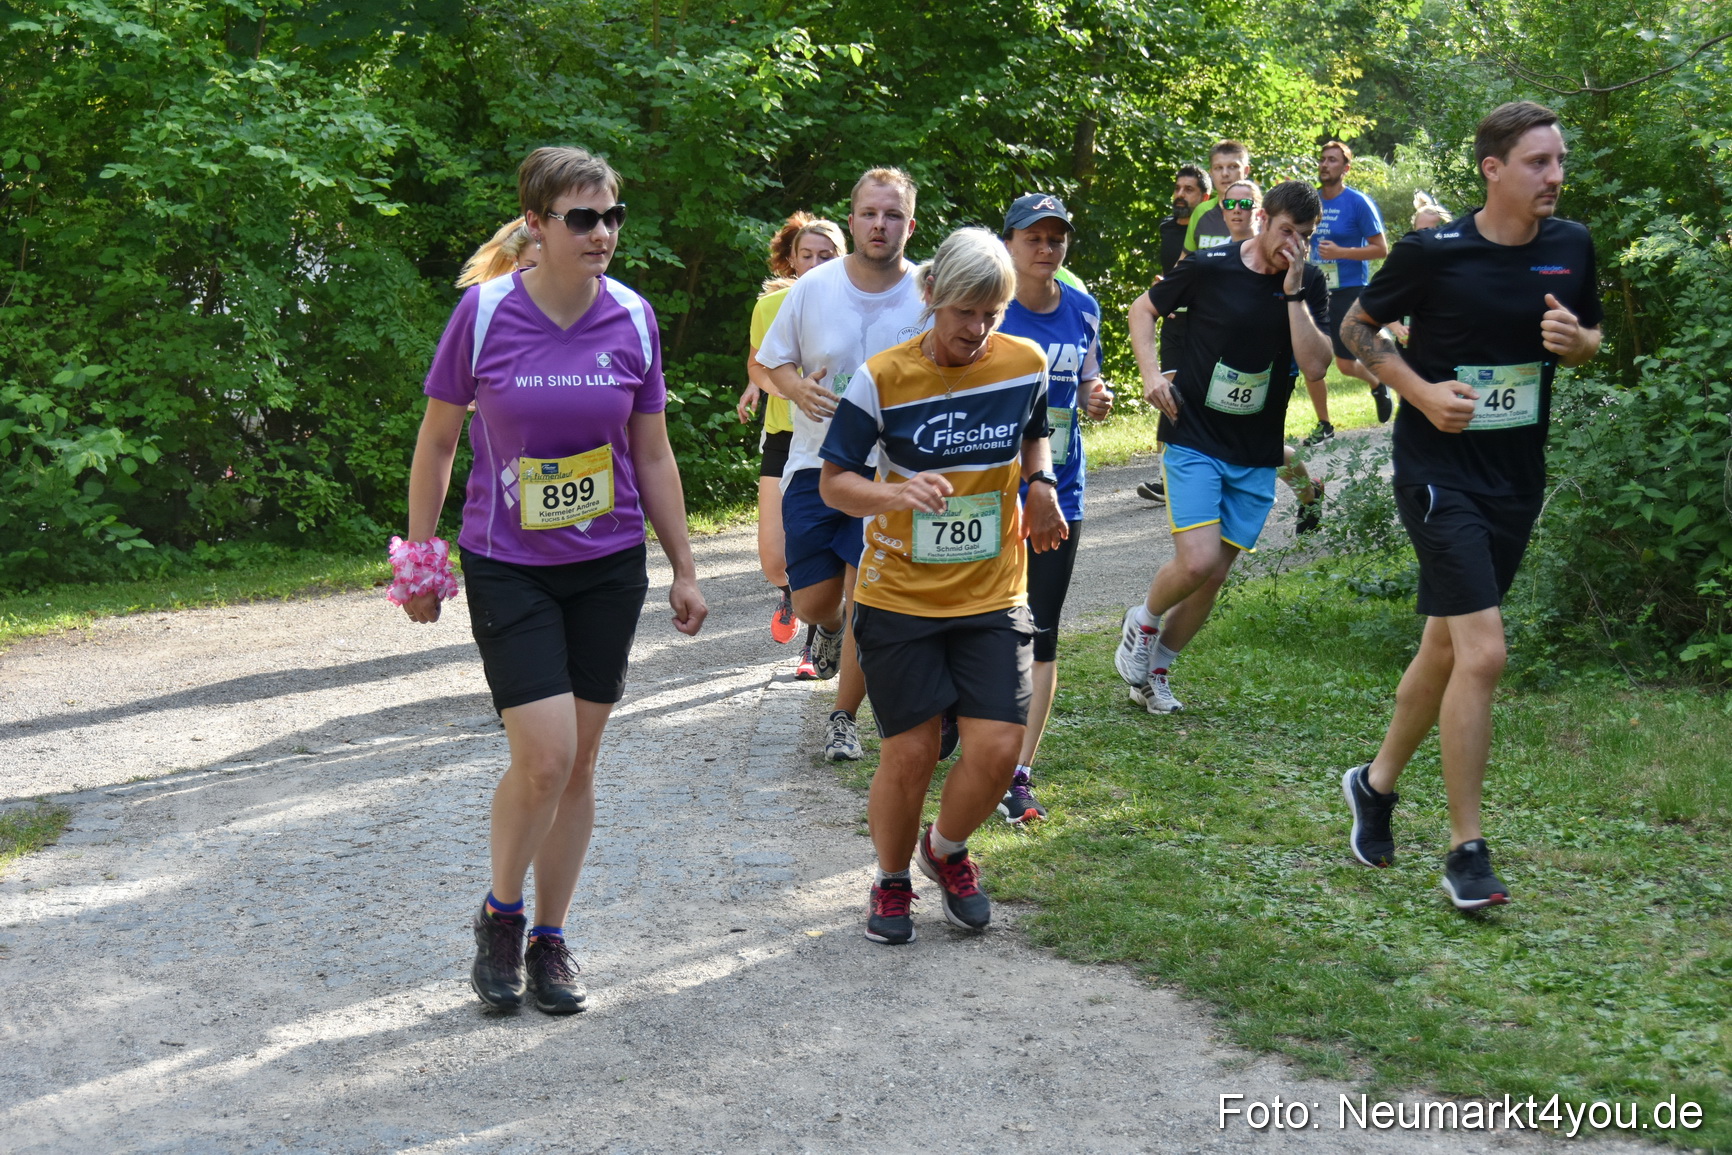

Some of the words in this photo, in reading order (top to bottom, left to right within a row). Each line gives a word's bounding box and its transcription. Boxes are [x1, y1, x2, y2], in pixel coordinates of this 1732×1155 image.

[515, 375, 543, 387] WIR
[547, 375, 582, 387] SIND
[586, 374, 620, 386] LILA.
[1227, 387, 1252, 403] 48
[1484, 388, 1516, 411] 46
[933, 422, 1018, 448] Fischer
[942, 439, 1012, 456] AUTOMOBILE
[543, 477, 594, 509] 899
[539, 508, 575, 517] Kiermeier
[576, 500, 600, 511] Andrea
[581, 507, 598, 515] Service
[932, 519, 982, 545] 780
